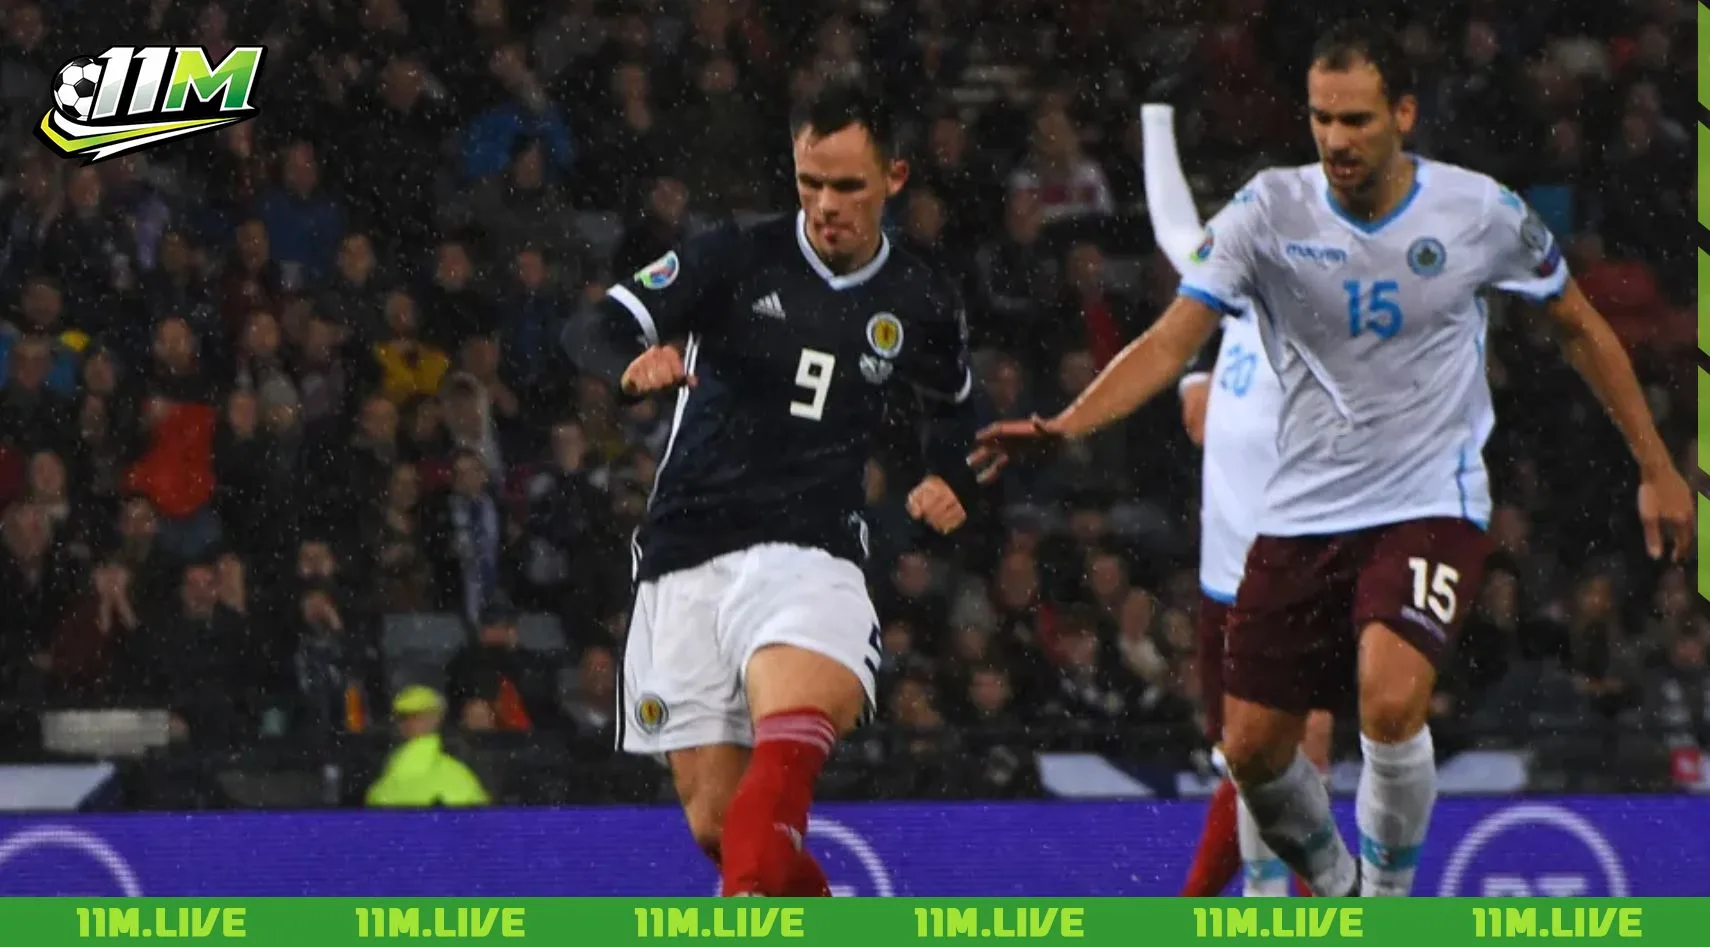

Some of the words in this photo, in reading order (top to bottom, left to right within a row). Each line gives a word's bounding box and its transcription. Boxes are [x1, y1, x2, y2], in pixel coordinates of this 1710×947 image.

[1343, 279, 1404, 341] 15
[789, 347, 836, 422] 9
[1220, 343, 1258, 398] 20
[1408, 557, 1459, 624] 15
